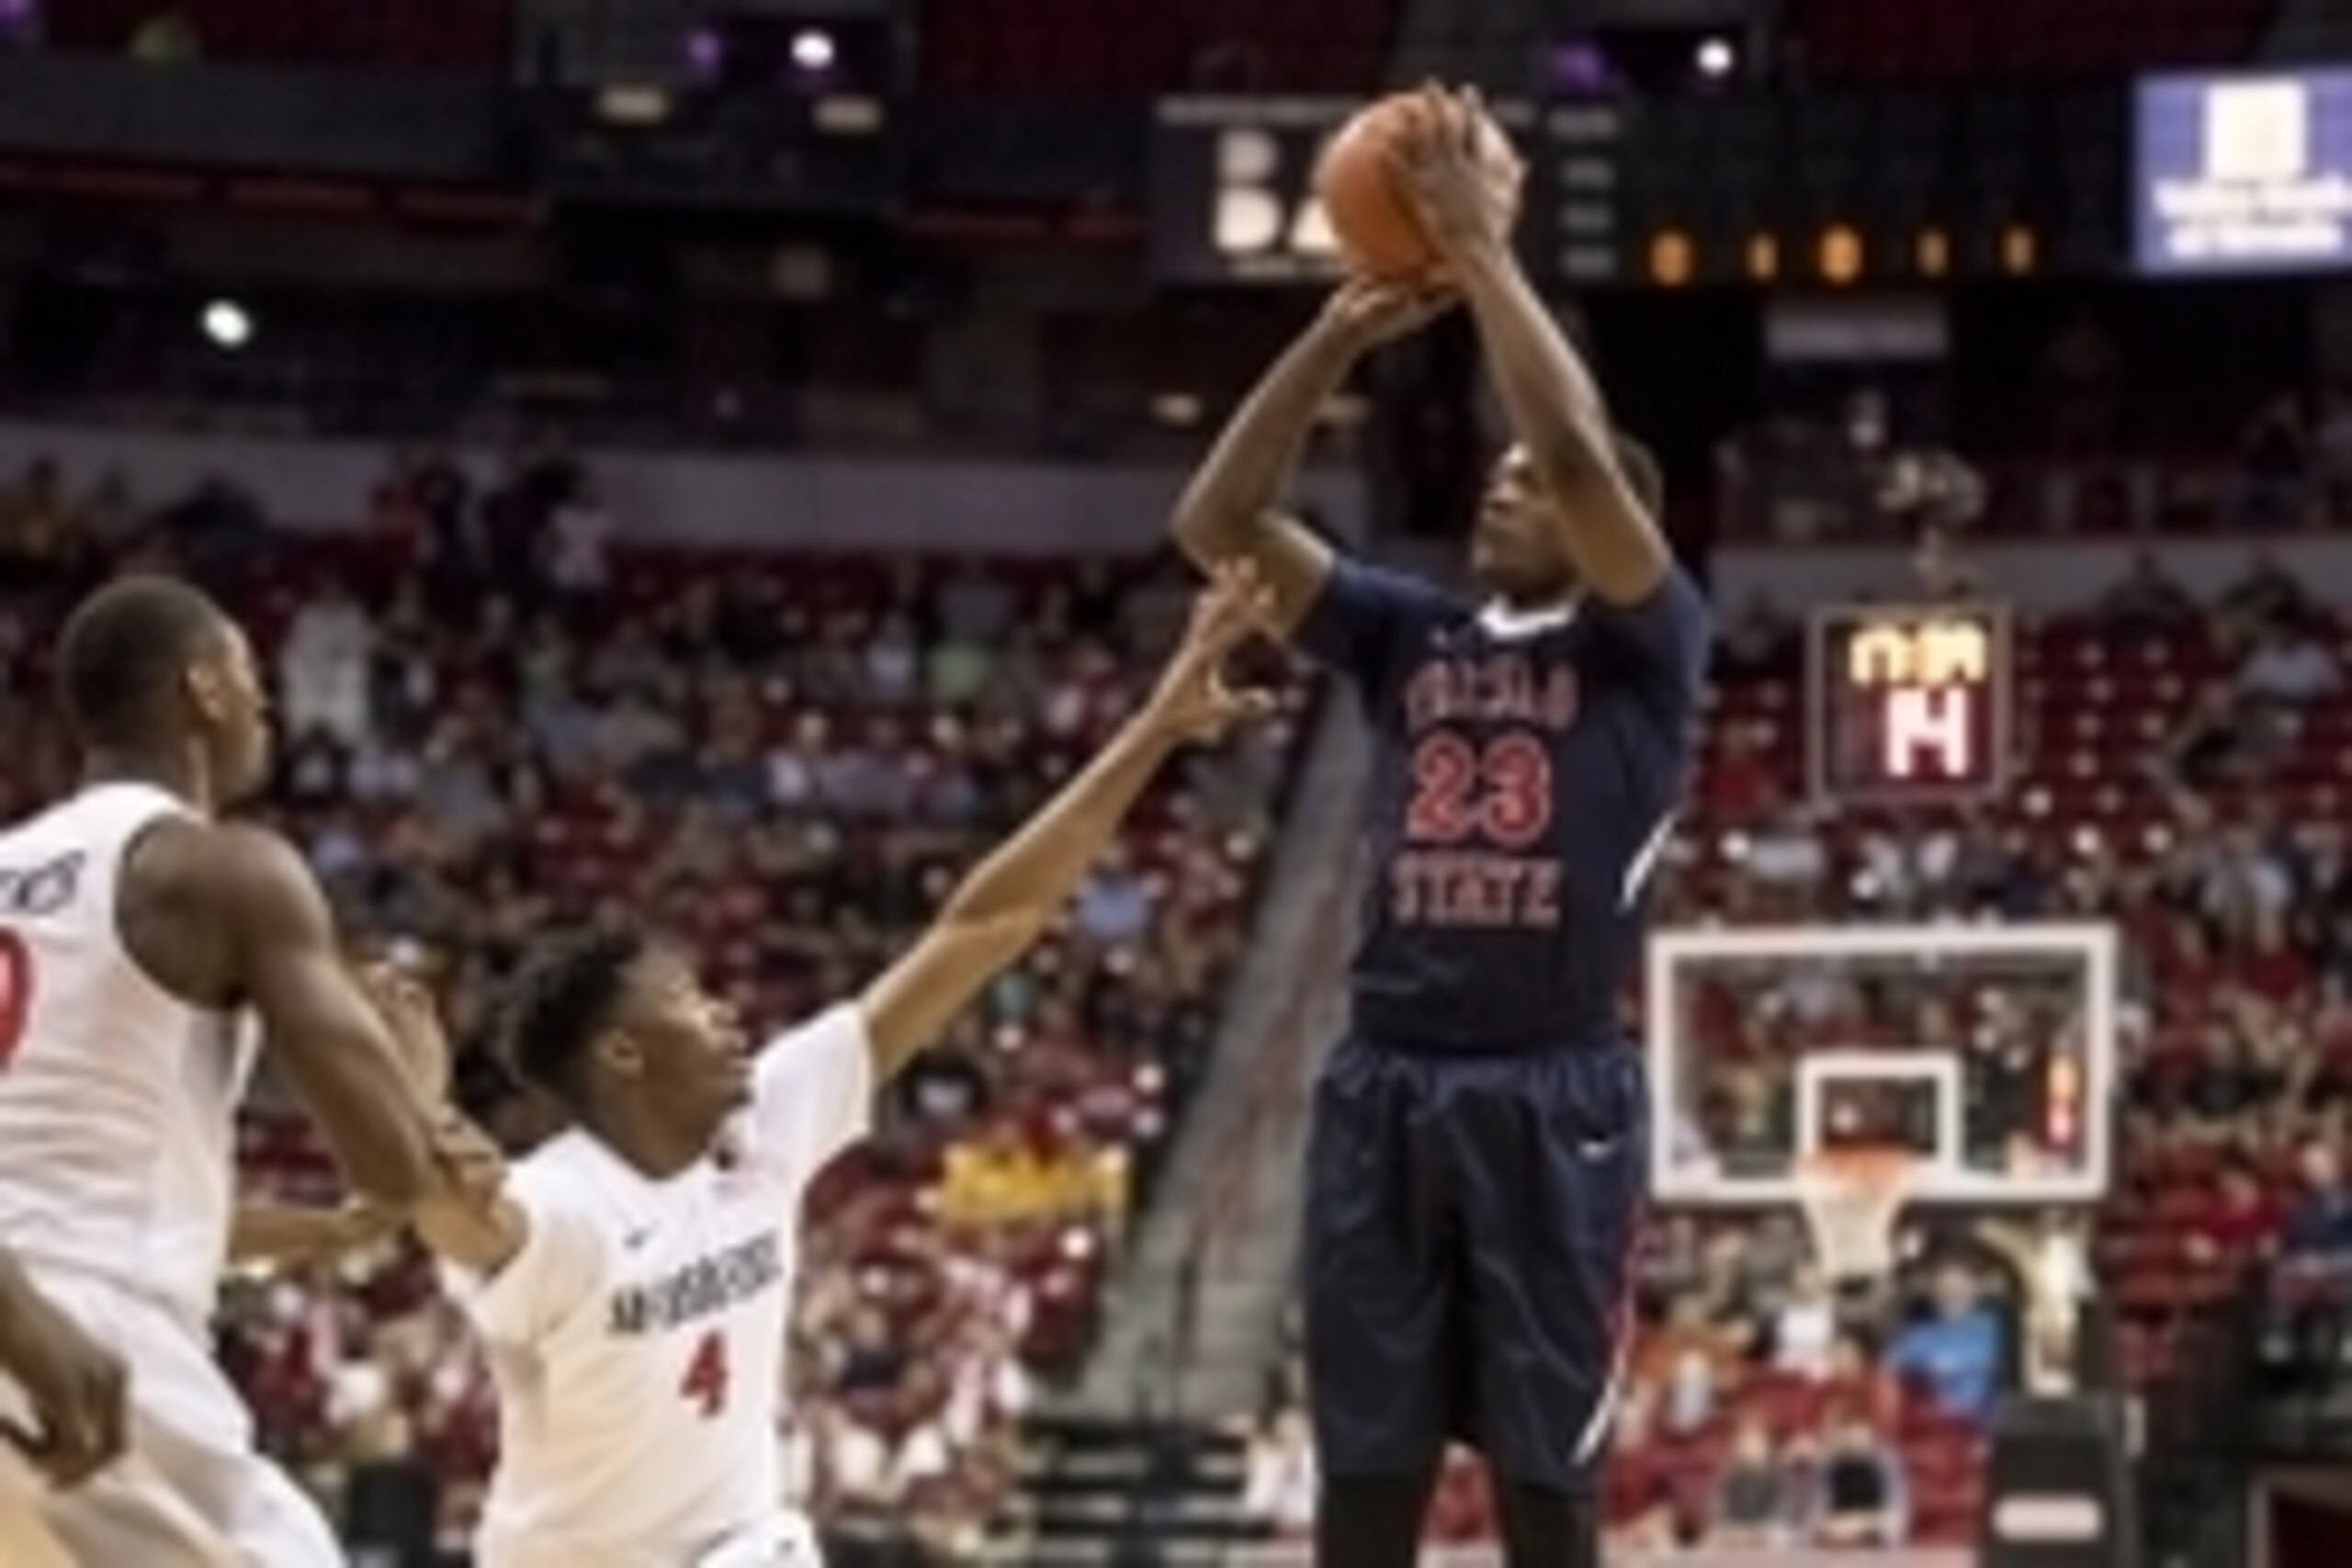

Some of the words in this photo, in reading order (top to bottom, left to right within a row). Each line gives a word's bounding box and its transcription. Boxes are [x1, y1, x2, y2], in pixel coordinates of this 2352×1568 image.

[1407, 730, 1554, 847] 23
[1394, 854, 1562, 926] STATE
[678, 1331, 729, 1419] 4
